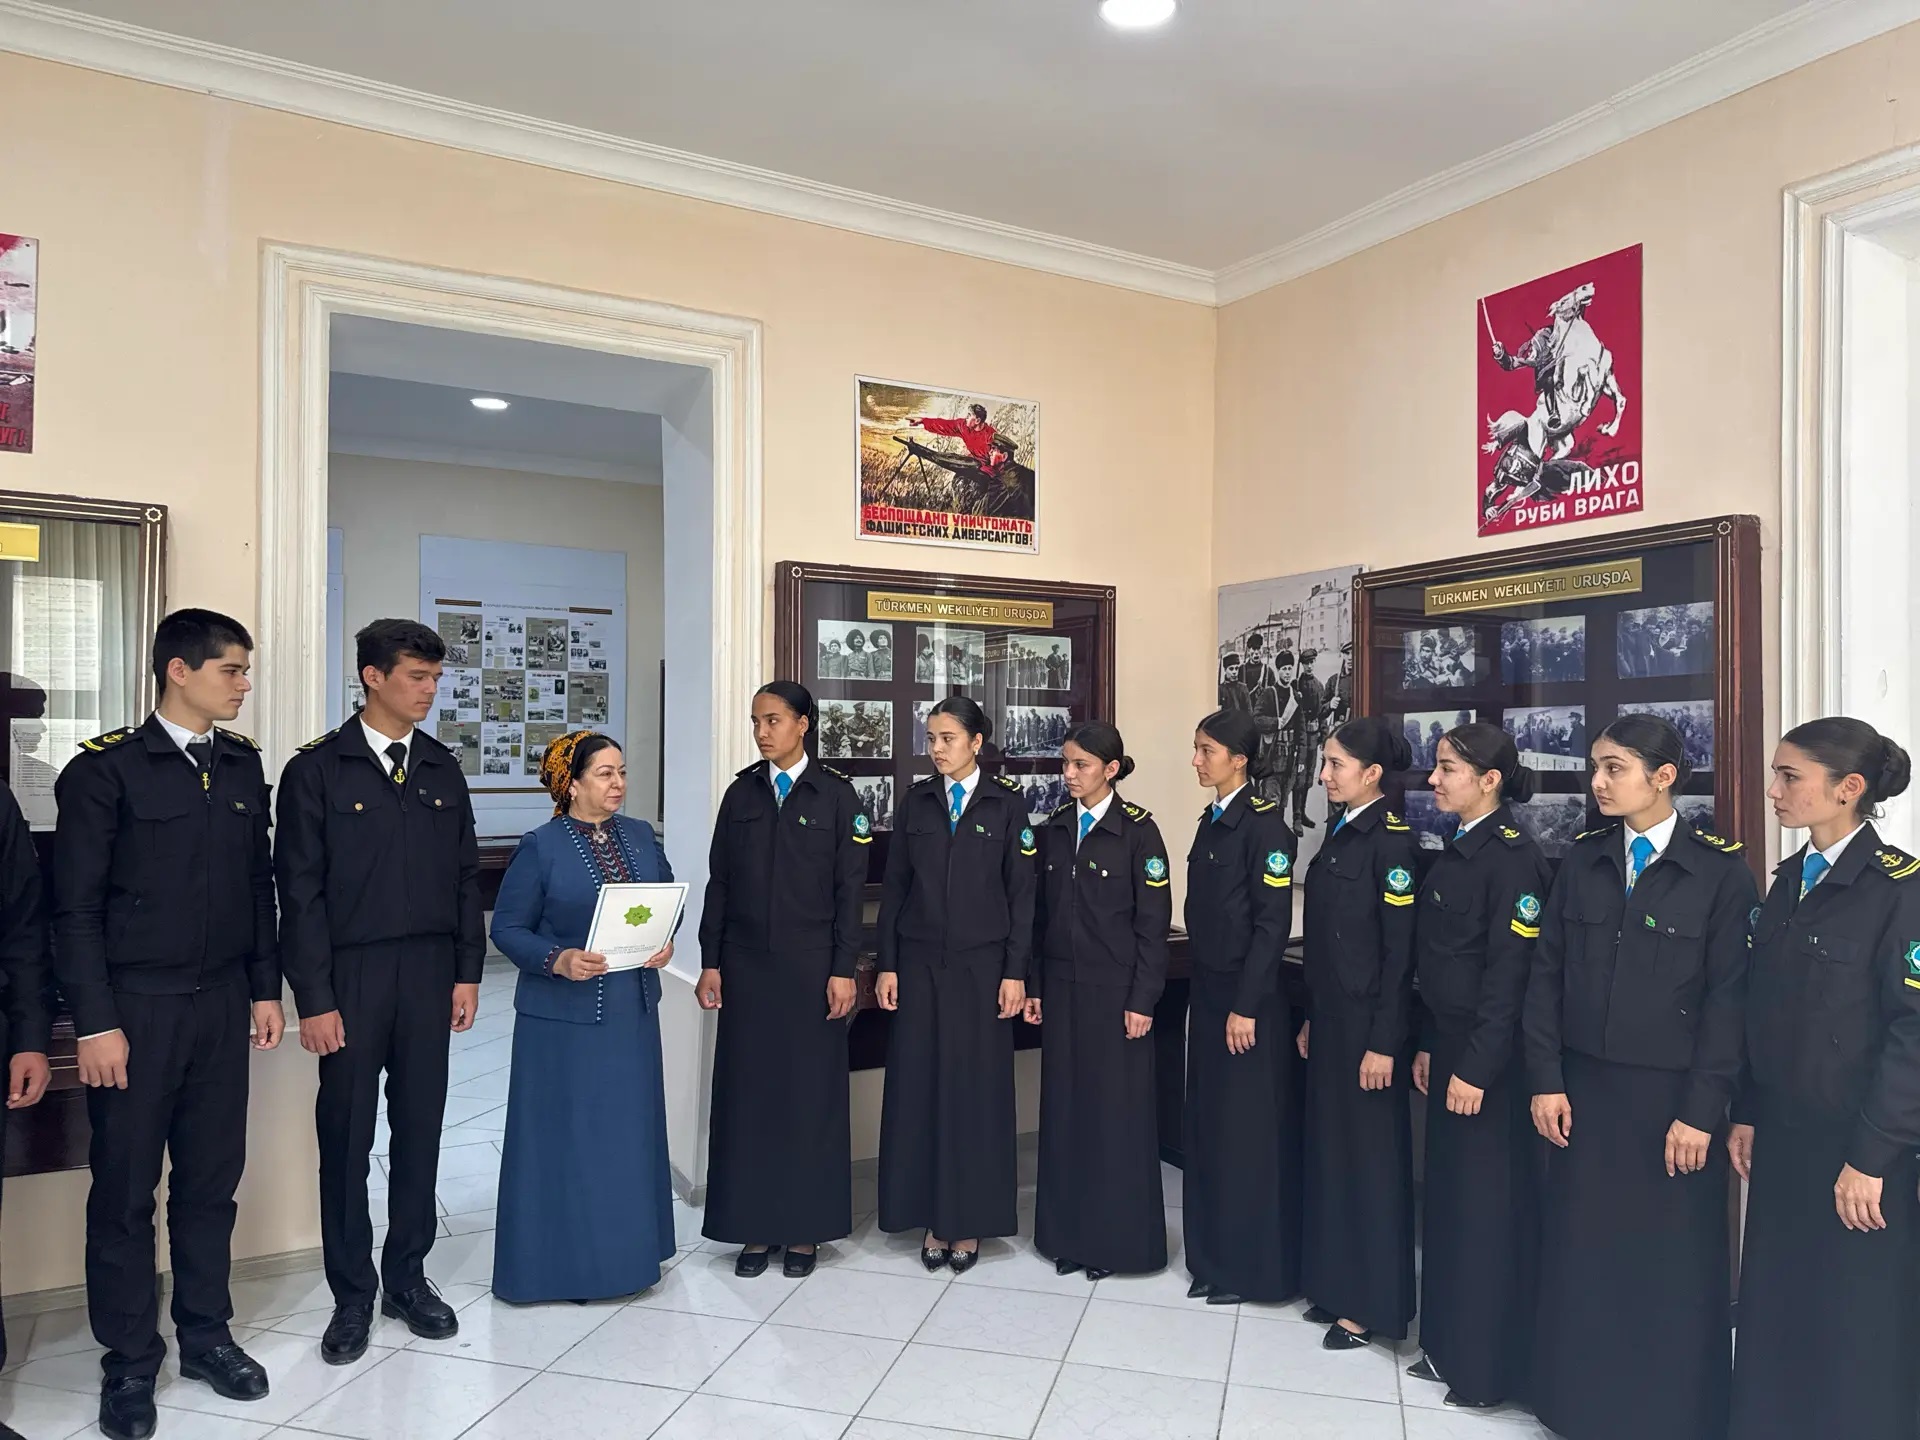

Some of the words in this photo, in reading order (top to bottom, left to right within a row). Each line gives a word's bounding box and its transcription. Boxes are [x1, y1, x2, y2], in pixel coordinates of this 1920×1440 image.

[1563, 461, 1639, 496] ЛИХО
[864, 505, 949, 526] БЕСПОЩАДНО
[952, 513, 1032, 533] УНИЧТОЖАТЬ
[1515, 501, 1565, 526] РУБИ
[1574, 489, 1640, 516] ВРАГА
[866, 520, 949, 539] ФАШИСТСКИХ
[952, 527, 1033, 546] ДИВЕРСАНТОВ!
[1431, 589, 1488, 606] TÜRKMEN
[1494, 578, 1566, 599] WEKILIÝETI
[1573, 570, 1632, 588] URUŞDA
[875, 598, 931, 614] TÜRKMEN
[937, 603, 998, 618] WEKILIÝETI
[1004, 607, 1048, 622] URUŞDA
